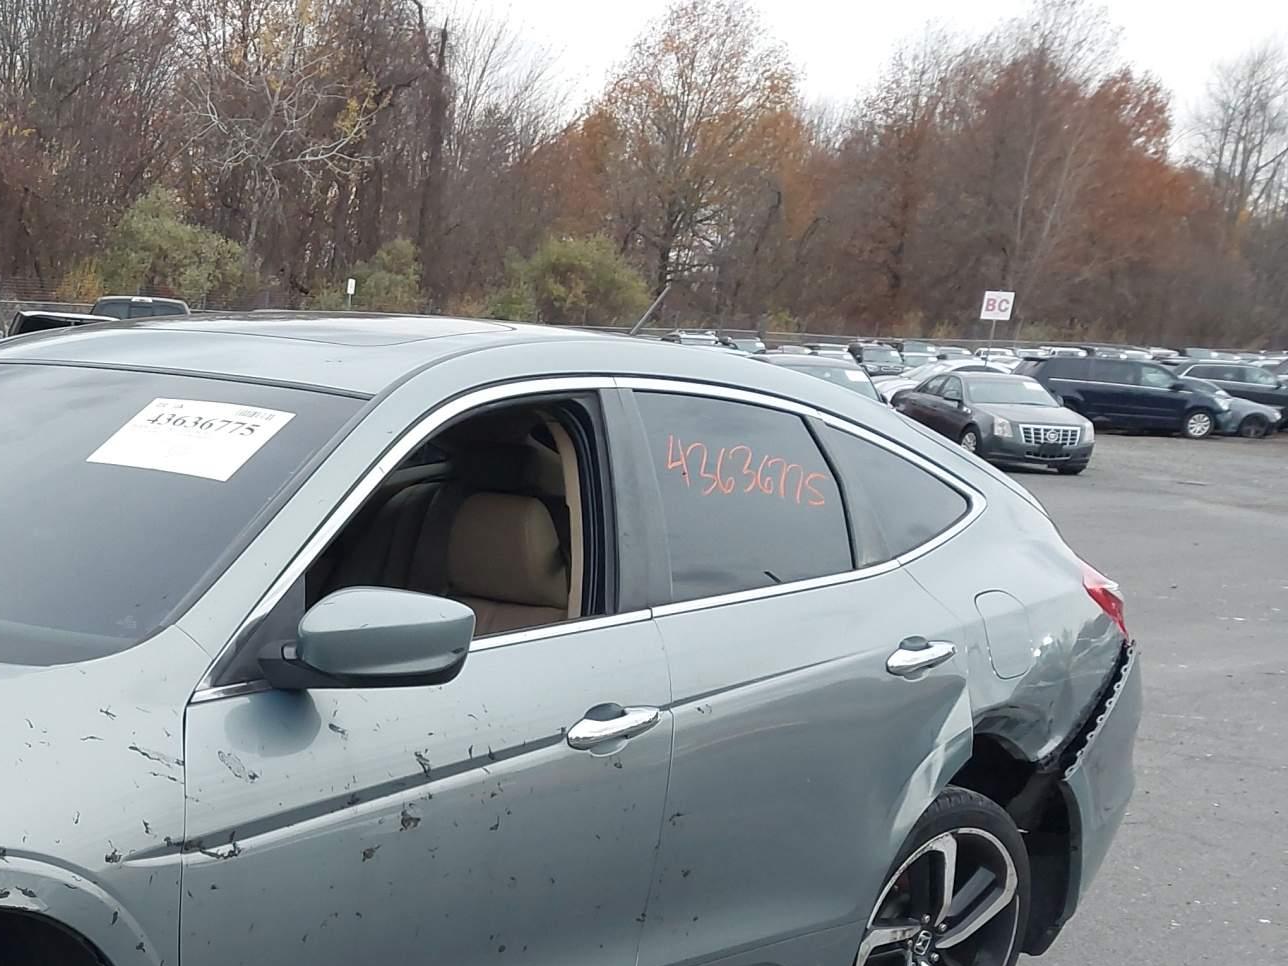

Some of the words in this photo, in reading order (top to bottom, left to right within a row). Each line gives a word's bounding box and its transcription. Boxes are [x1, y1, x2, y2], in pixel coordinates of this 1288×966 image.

[984, 297, 1010, 313] BC
[147, 413, 261, 437] 43636775
[666, 433, 826, 506] 43636775
